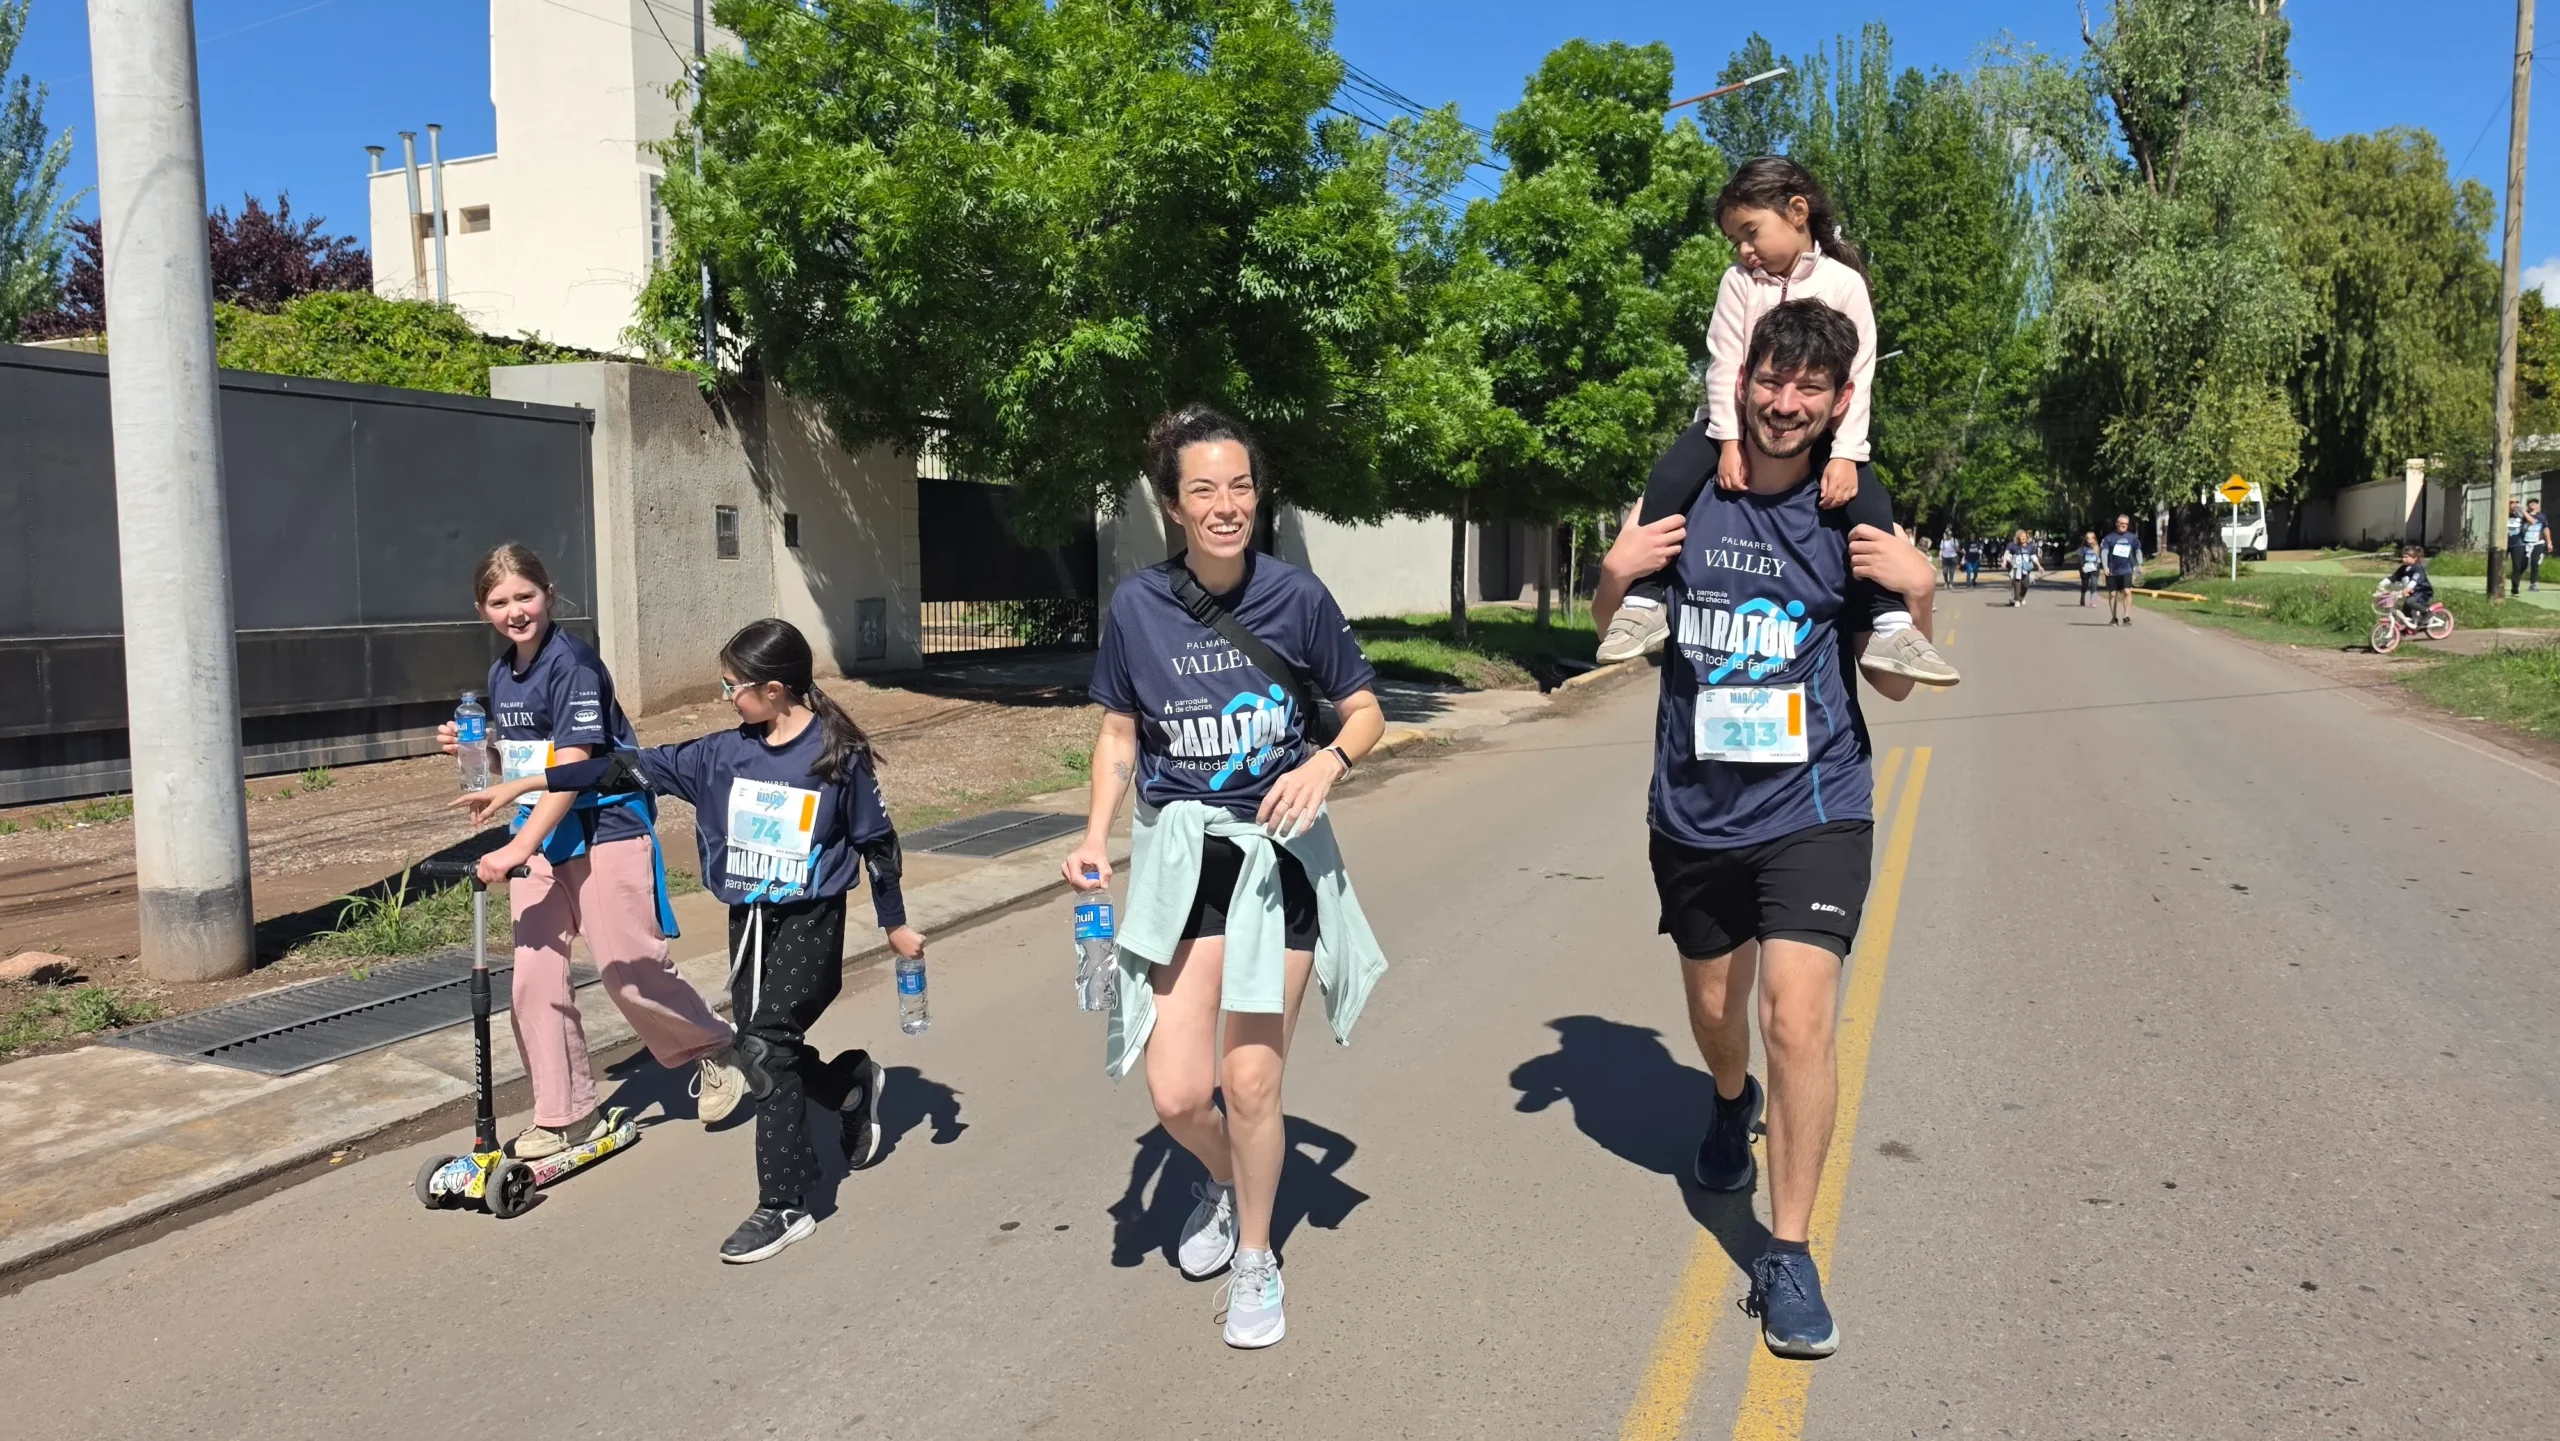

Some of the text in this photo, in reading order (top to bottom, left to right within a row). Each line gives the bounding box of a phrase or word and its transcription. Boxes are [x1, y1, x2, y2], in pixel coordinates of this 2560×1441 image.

[1721, 536, 1773, 551] PALMARES
[1705, 549, 1787, 577] VALLEY
[1696, 589, 1728, 598] parroquia
[1705, 597, 1731, 605] chacras
[1677, 604, 1798, 659] MARATÓN
[1186, 638, 1231, 650] PALMAR
[1705, 653, 1729, 668] toda
[1733, 657, 1744, 670] la
[1175, 697, 1208, 706] parroquia
[1185, 703, 1213, 712] chacras
[1159, 697, 1286, 757] MARATÓN
[1723, 721, 1778, 747] 213
[1170, 746, 1285, 773] para toda la familia
[751, 816, 782, 843] 74
[724, 878, 743, 889] para
[743, 880, 759, 891] toda
[1075, 911, 1093, 923] huil
